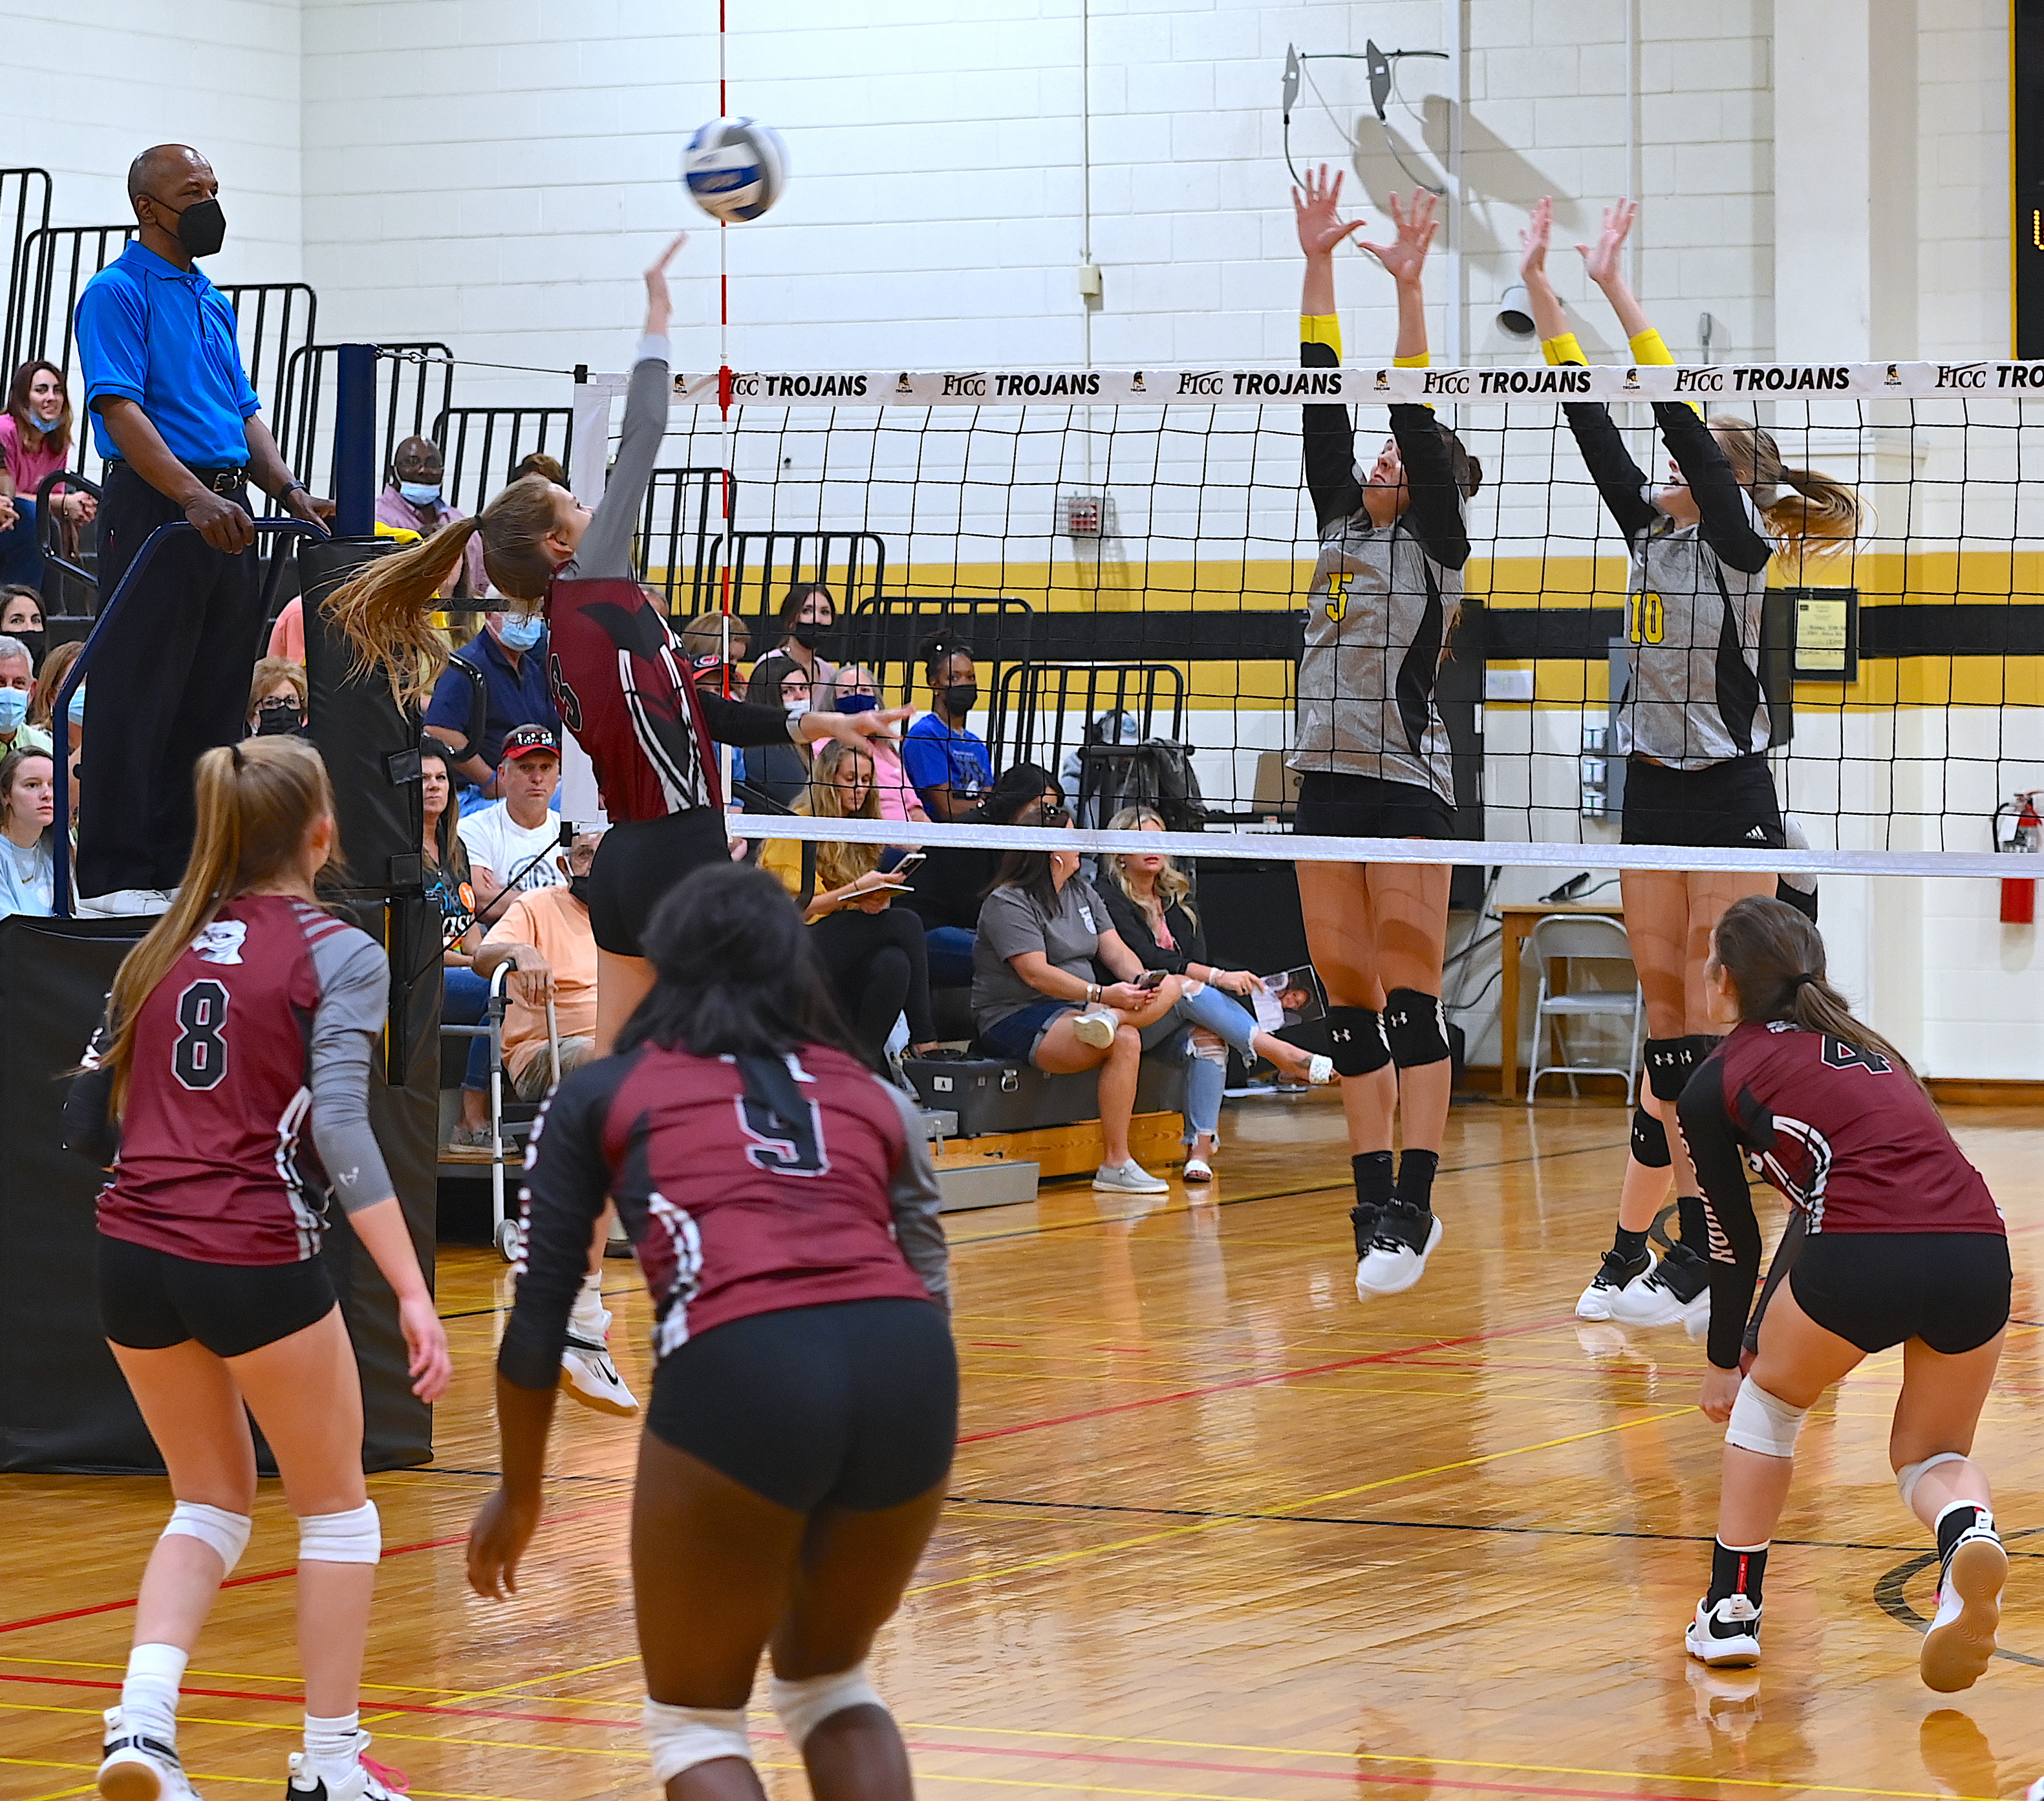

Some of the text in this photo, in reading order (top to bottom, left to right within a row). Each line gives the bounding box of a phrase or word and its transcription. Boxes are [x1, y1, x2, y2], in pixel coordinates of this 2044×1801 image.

[766, 376, 867, 396] TROJANS
[941, 372, 1101, 396] FTCC TROJANS
[1177, 371, 1342, 395] FTCC TROJANS
[1423, 369, 1591, 394] FTCC TROJANS
[1673, 367, 1849, 392] FTCC TROJANS
[1935, 362, 1988, 388] FTCC
[1324, 572, 1354, 623] 5
[1629, 588, 1664, 643] 10
[171, 978, 231, 1091] 8
[1821, 1034, 1893, 1075] 4
[734, 1093, 832, 1176] 9
